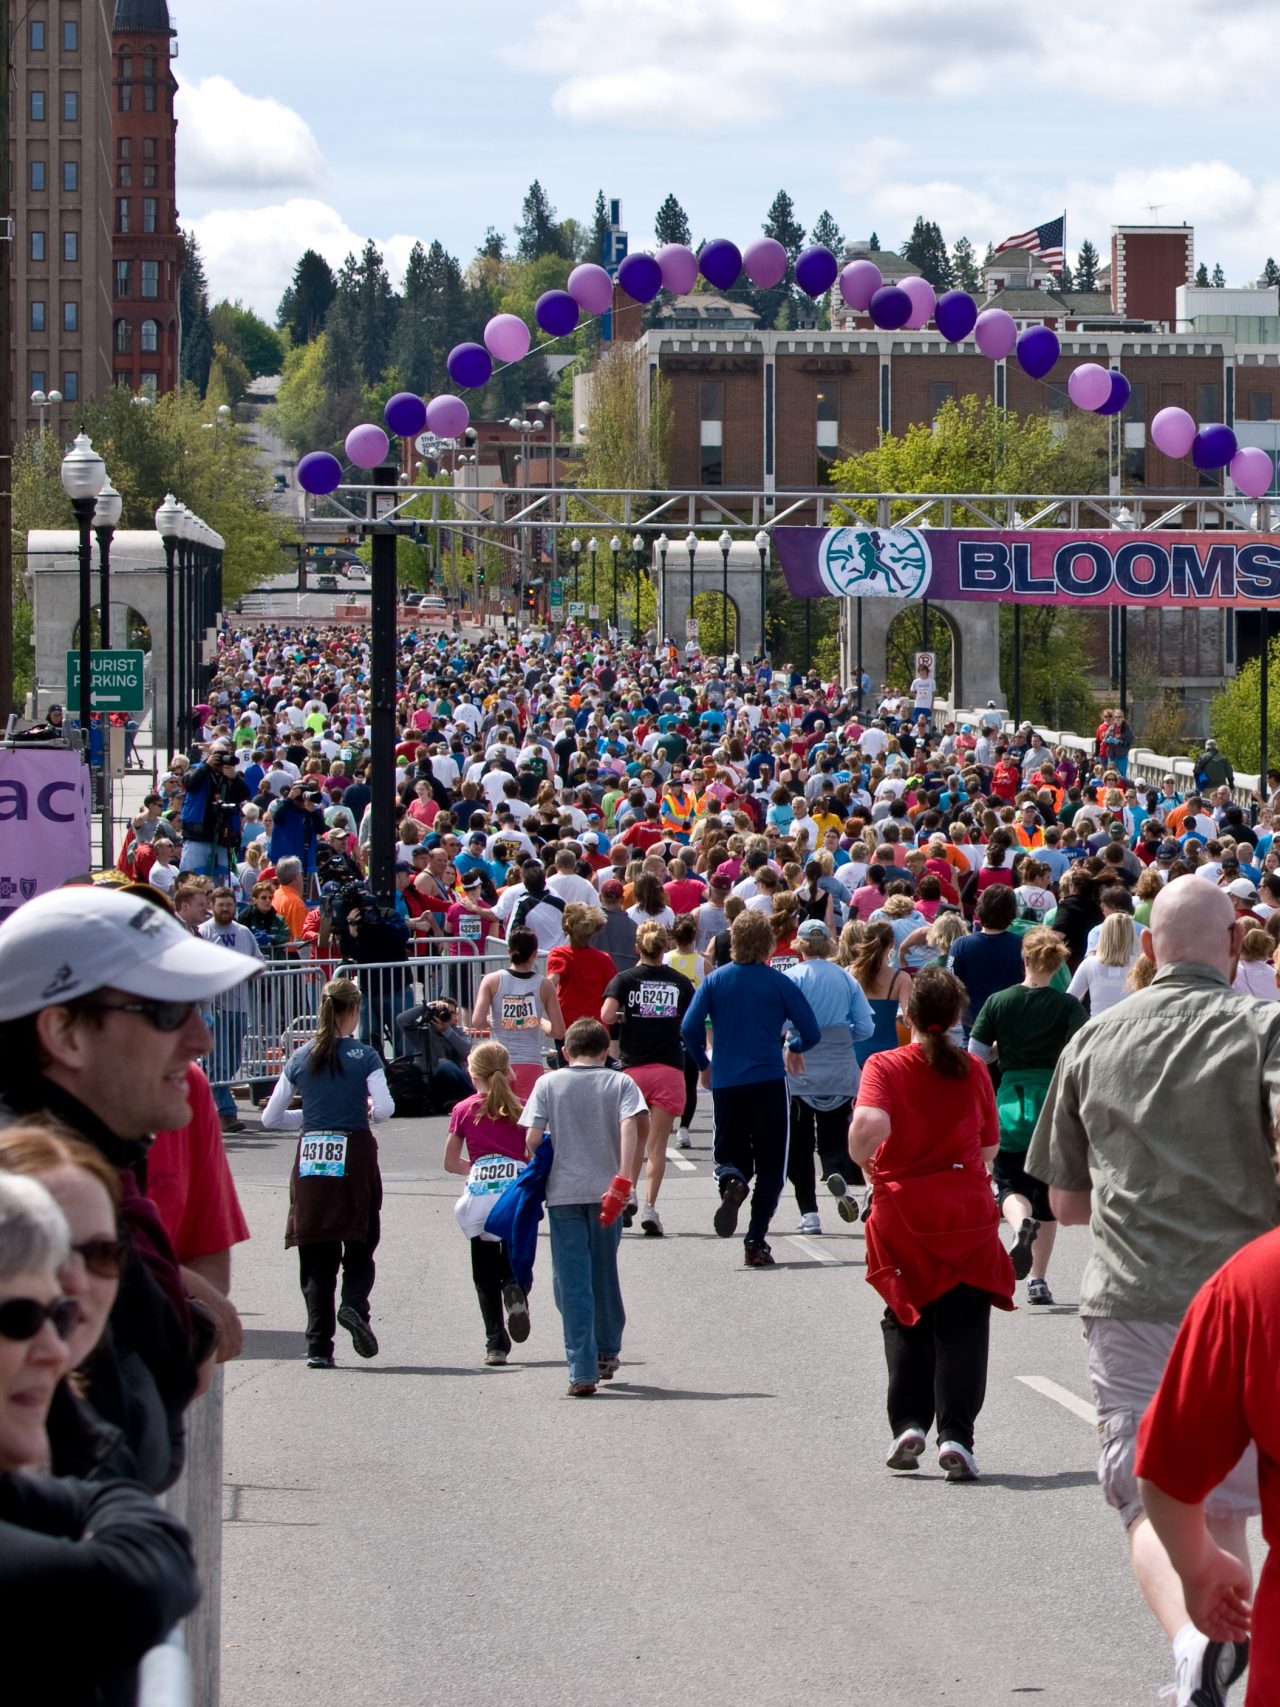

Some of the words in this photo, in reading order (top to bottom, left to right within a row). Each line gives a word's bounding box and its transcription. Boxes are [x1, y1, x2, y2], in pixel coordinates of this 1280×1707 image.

[73, 659, 137, 672] TURIST
[73, 674, 138, 688] PRKING
[220, 933, 236, 947] W
[642, 989, 675, 1006] 62471
[503, 1002, 534, 1018] 22031
[302, 1142, 344, 1161] 43183
